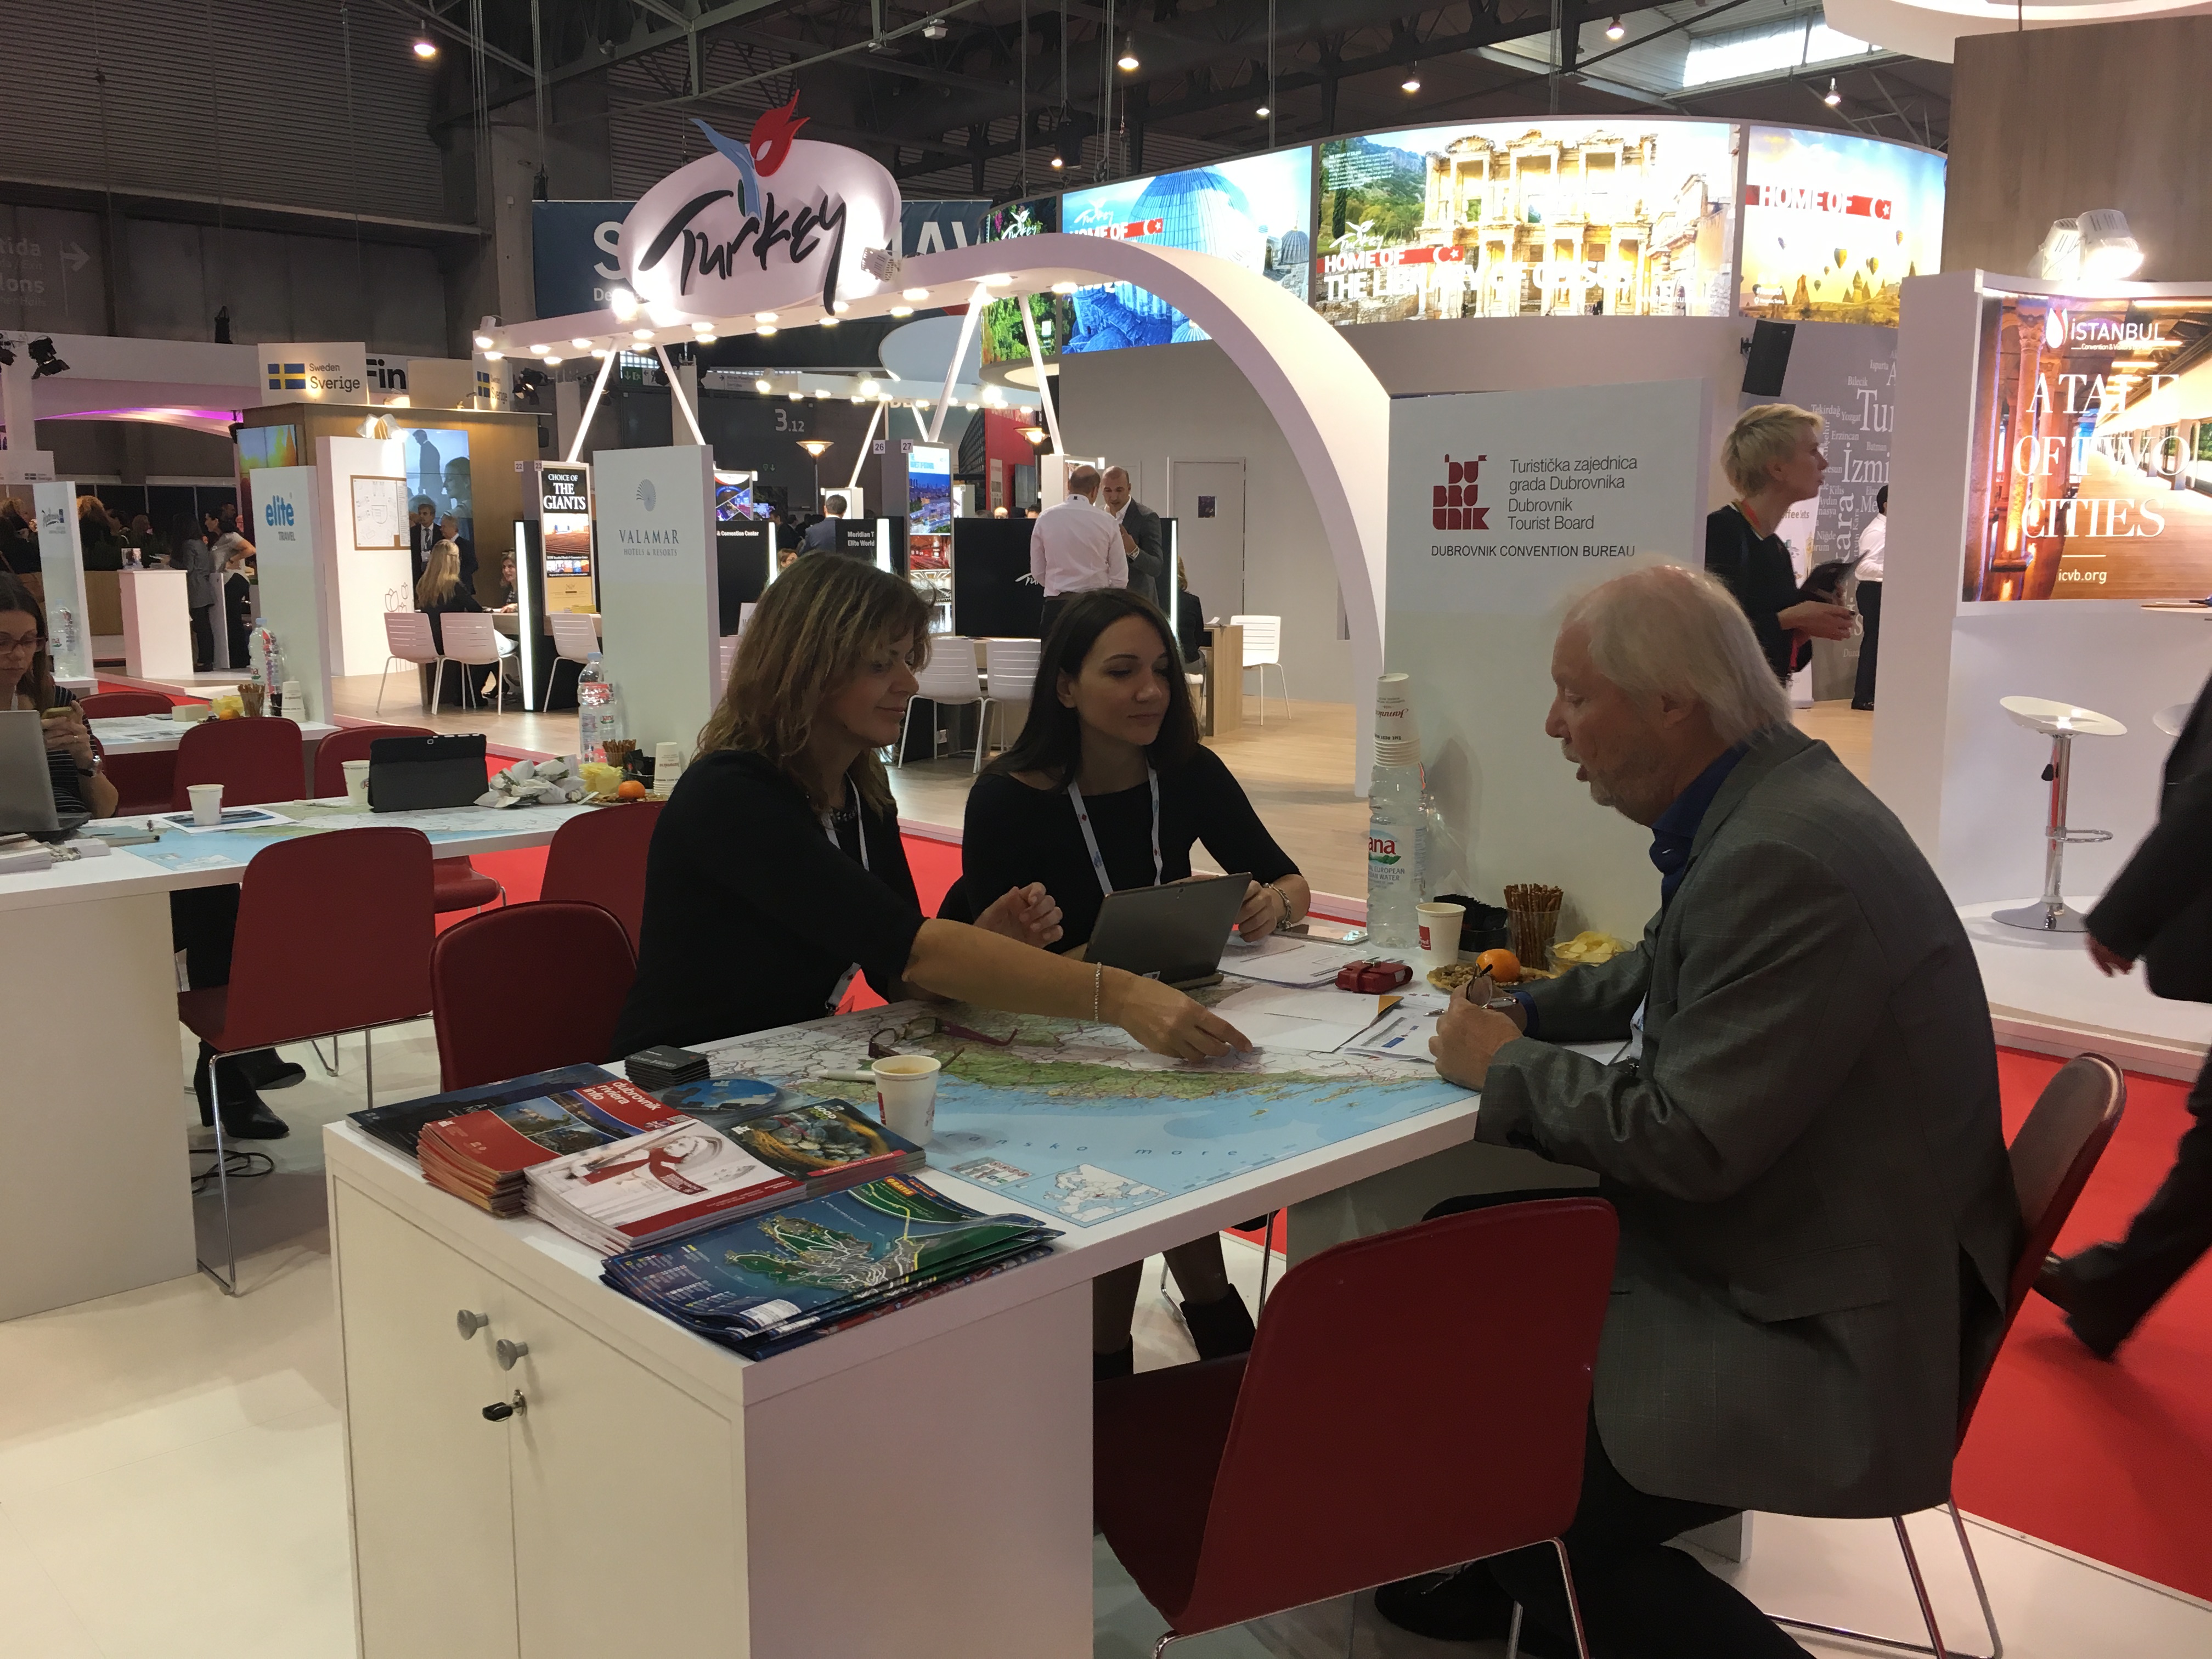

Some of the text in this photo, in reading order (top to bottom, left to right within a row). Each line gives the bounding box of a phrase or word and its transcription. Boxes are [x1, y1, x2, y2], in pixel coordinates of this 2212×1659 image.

[1759, 185, 1853, 214] HOME OF
[637, 190, 847, 316] Turkey
[1324, 248, 1405, 273] HOME OF
[1323, 272, 1368, 301] THE
[309, 363, 340, 372] Sweden
[310, 376, 360, 393] Sverige
[1847, 376, 1868, 386] Bilecik
[2025, 372, 2053, 414] A
[1842, 411, 1861, 424] Yozgat
[1831, 430, 1860, 441] Erzincan
[875, 443, 884, 451] 26
[903, 442, 912, 450] 27
[1842, 442, 1891, 483] İzmi
[2013, 435, 2191, 477] OF TWO
[1510, 456, 1638, 474] Turistička zajednica
[553, 482, 575, 495] THE
[1509, 475, 1626, 495] grada Dubrovnika
[543, 495, 586, 510] GIANTS
[1508, 497, 1573, 512] Dubrovnik
[266, 495, 295, 527] elite
[1818, 508, 1837, 518] masya
[2021, 498, 2165, 539] CITIES
[1508, 515, 1595, 531] Tourist Board
[278, 531, 296, 541] TRAVEL
[619, 529, 680, 544] VALAMAR
[1816, 531, 1837, 543] Niğde
[1431, 545, 1635, 557] DUBROVNIK CONVENTION BUREAU
[2058, 569, 2107, 584] icvb.org
[1368, 836, 1396, 855] ana
[1374, 866, 1406, 874] EUROPEAN
[582, 1087, 604, 1101] info
[597, 1085, 630, 1105] riviera
[612, 1081, 662, 1111] dubrovnik
[814, 1105, 837, 1119] GOOD
[886, 1178, 913, 1195] GRATIS
